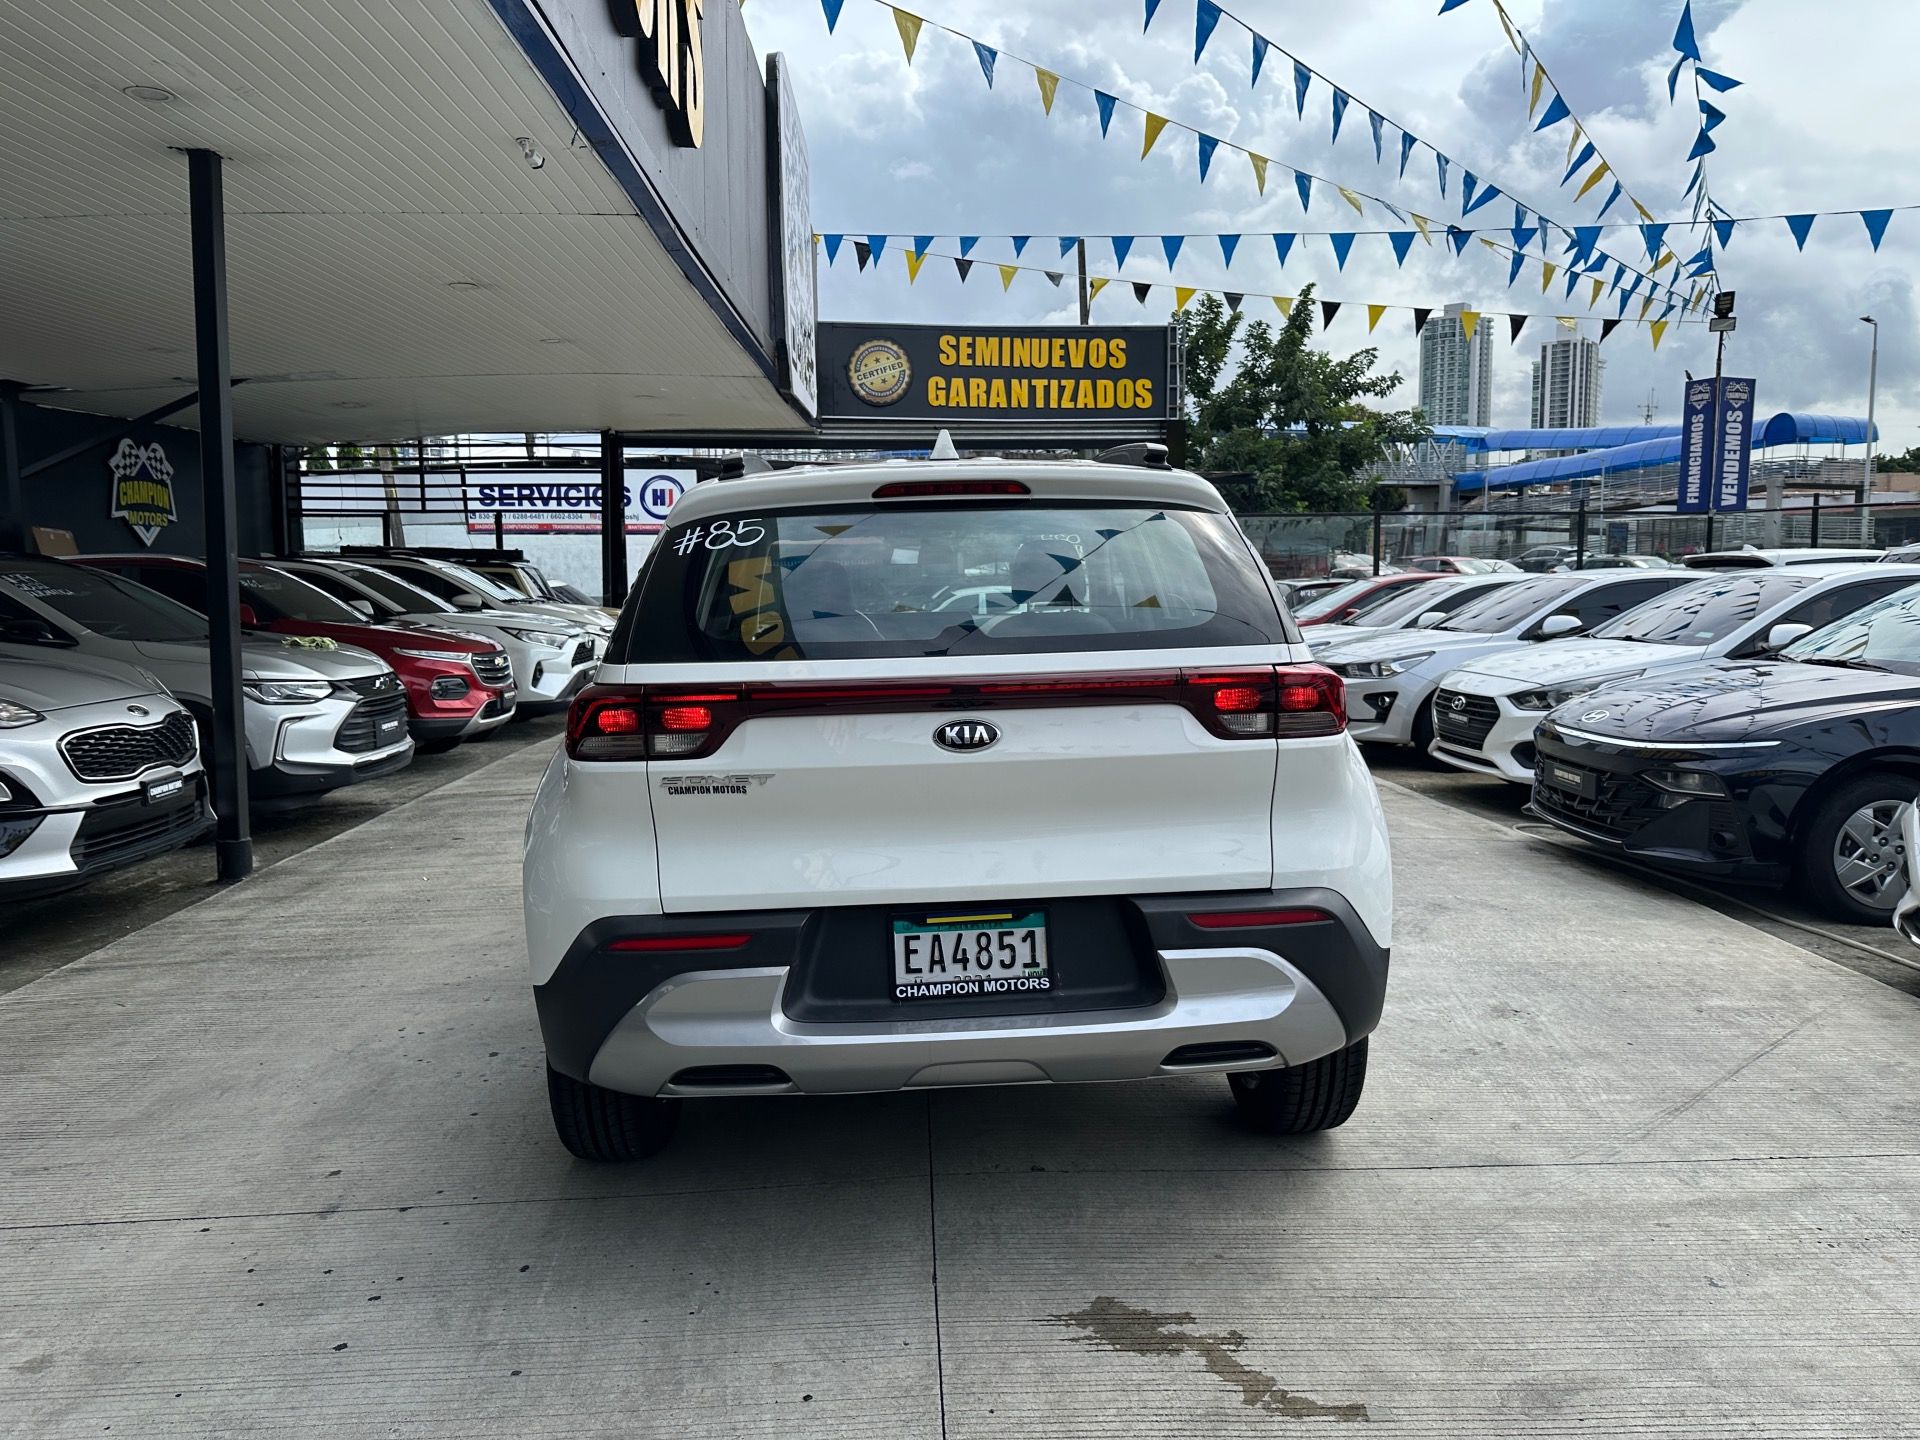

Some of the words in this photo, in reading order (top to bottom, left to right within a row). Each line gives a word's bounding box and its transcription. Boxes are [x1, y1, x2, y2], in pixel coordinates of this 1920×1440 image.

[939, 335, 1127, 369] SEMINUEVOS
[856, 361, 904, 381] CERTIFIED
[927, 375, 1153, 409] GARANTIZADOS
[1686, 413, 1705, 504] FINANCIAMOS
[1721, 410, 1744, 506] VENDEMOS
[119, 480, 170, 510] CHAMPION
[128, 511, 168, 527] MOTORS
[672, 518, 766, 556] #85
[945, 725, 990, 745] KIA
[660, 773, 776, 787] SONET
[668, 785, 711, 796] CHAMPION
[712, 785, 748, 795] MOTORS
[903, 929, 1041, 975] EA4851
[895, 981, 979, 998] CHAMPION
[983, 977, 1051, 993] MOTORS
